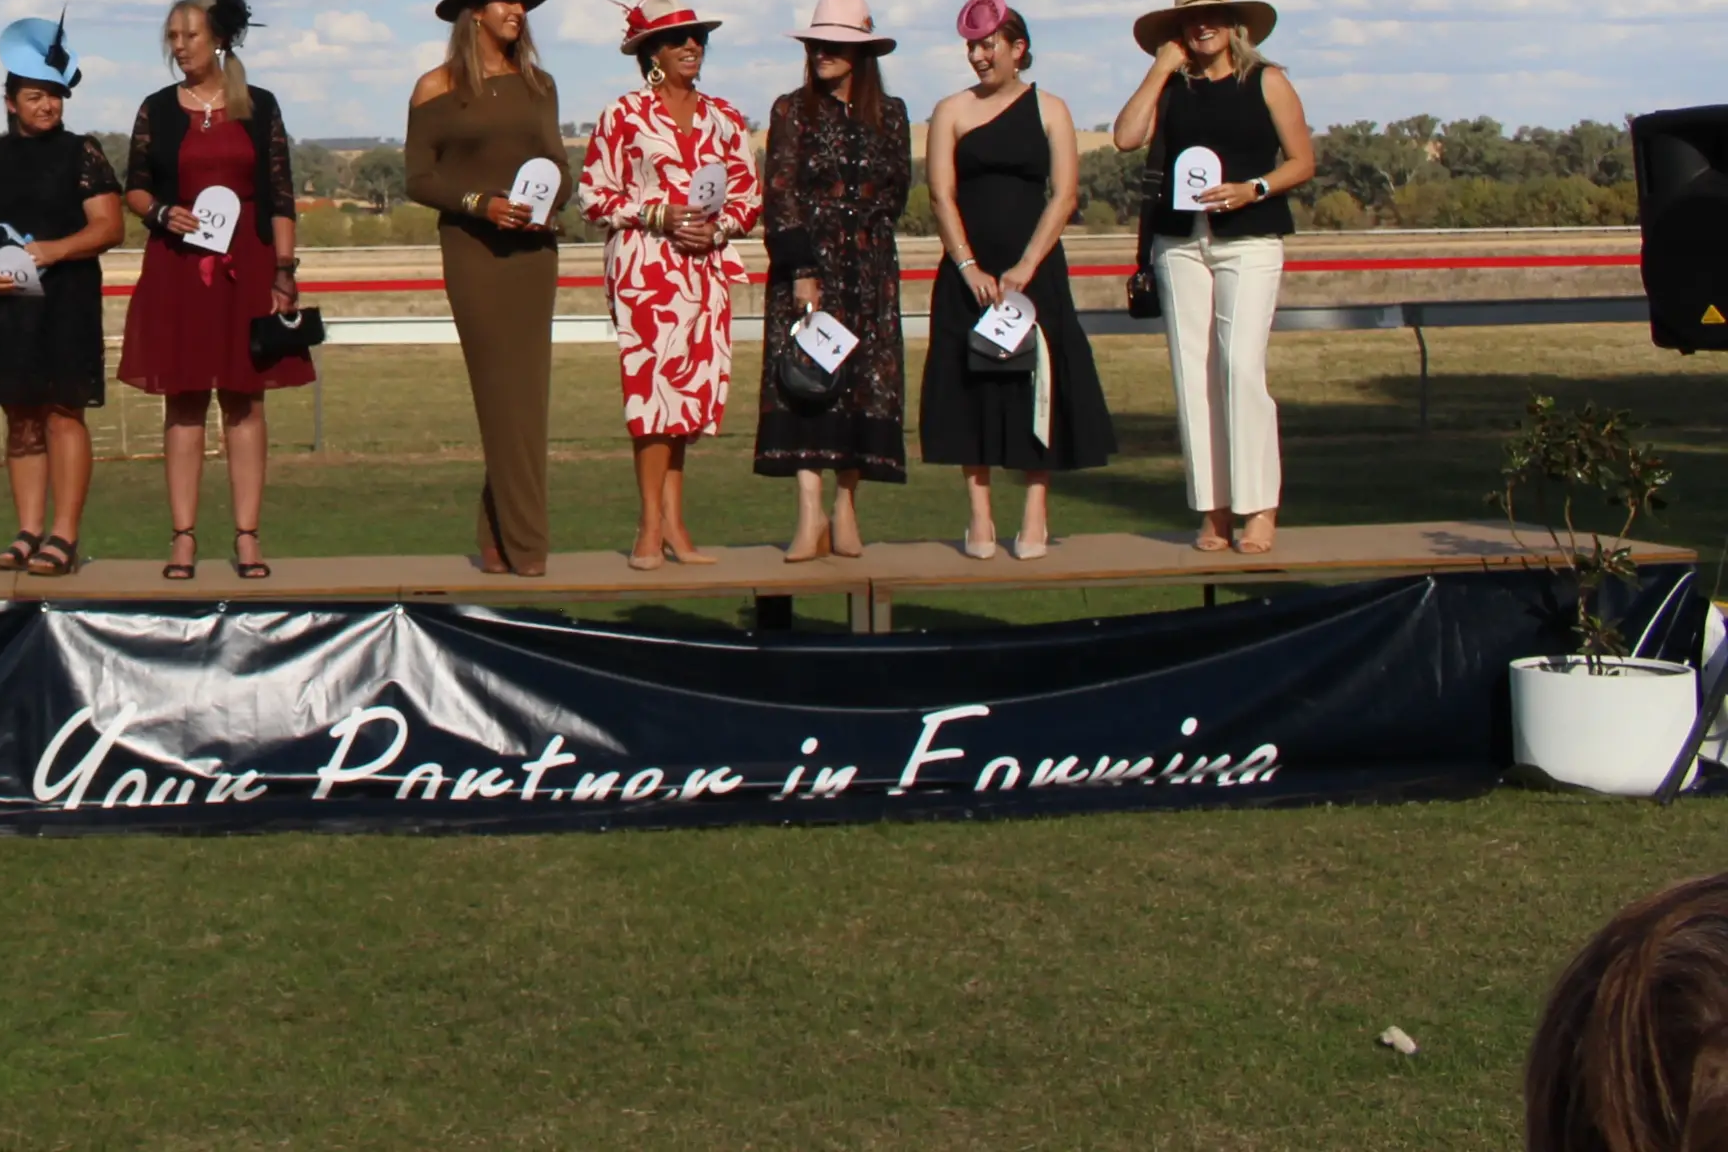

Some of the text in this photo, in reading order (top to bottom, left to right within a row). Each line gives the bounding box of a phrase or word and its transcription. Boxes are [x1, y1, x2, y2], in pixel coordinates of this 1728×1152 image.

[1187, 167, 1207, 189] 8
[518, 180, 549, 201] 12
[698, 181, 715, 201] 3
[198, 208, 226, 229] 20
[998, 304, 1023, 329] 2
[816, 327, 832, 346] 4
[768, 736, 858, 802] in
